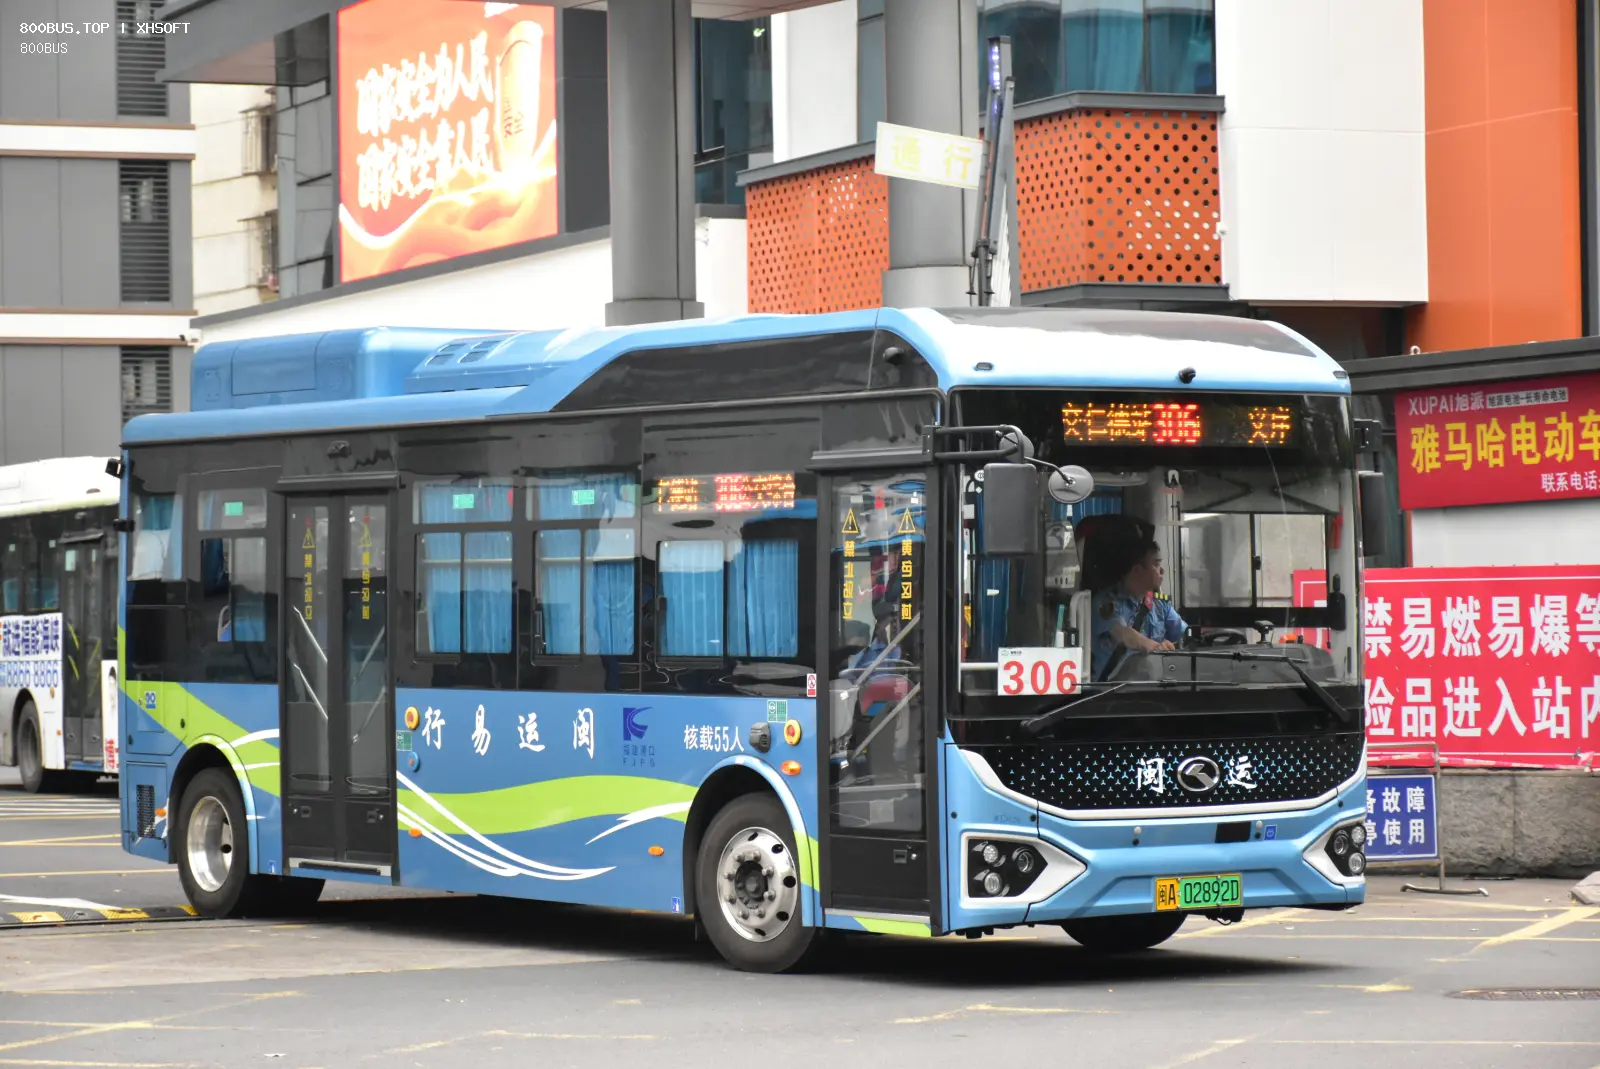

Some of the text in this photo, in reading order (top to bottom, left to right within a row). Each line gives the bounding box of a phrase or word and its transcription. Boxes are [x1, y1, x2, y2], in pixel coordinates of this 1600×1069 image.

[891, 135, 973, 180] 通行
[1410, 408, 1600, 474] 雅马哈电动车
[1003, 660, 1077, 695] 306
[684, 725, 744, 752] 核载55人
